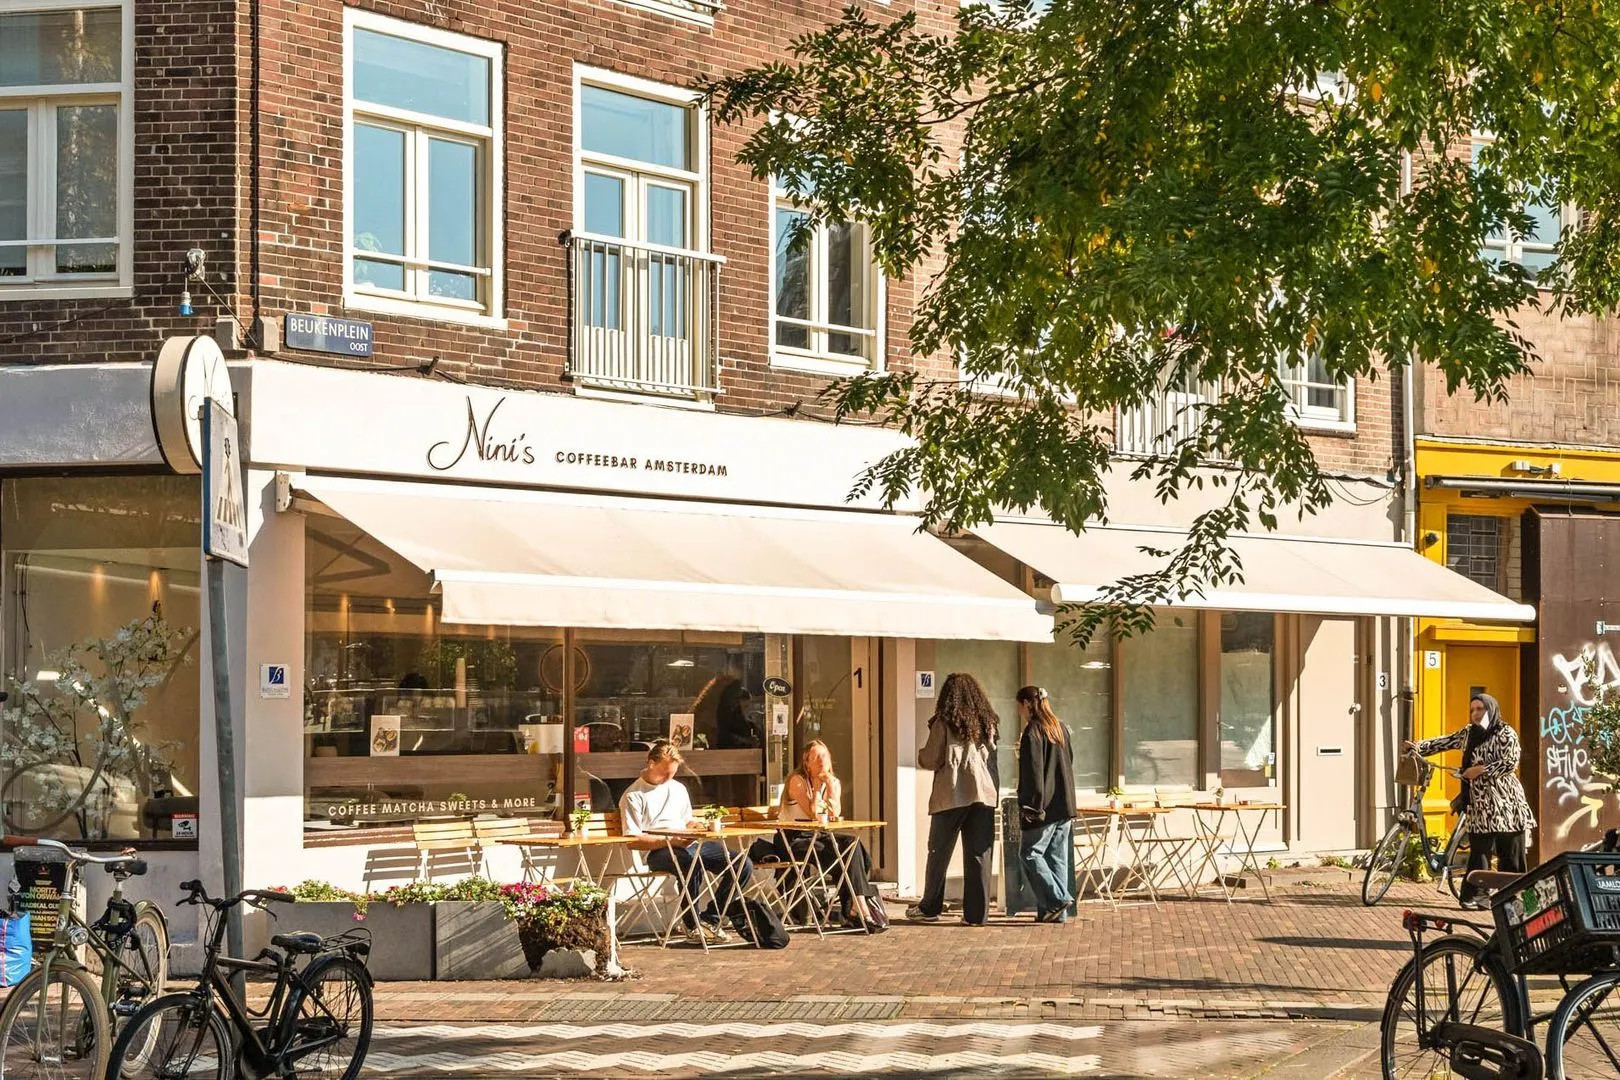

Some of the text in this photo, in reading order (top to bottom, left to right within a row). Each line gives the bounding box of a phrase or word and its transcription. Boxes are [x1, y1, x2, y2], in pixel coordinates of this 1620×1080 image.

[290, 317, 369, 340] BEUKENPLEIN
[349, 342, 368, 352] OOST
[427, 395, 536, 471] Nini's
[555, 450, 729, 477] COFFEEBAR AMSTERDAM
[1428, 652, 1437, 667] 5
[853, 667, 862, 688] 1
[1379, 675, 1386, 688] 3
[328, 797, 536, 816] COFFEE MATCHA SWEETS & MORE
